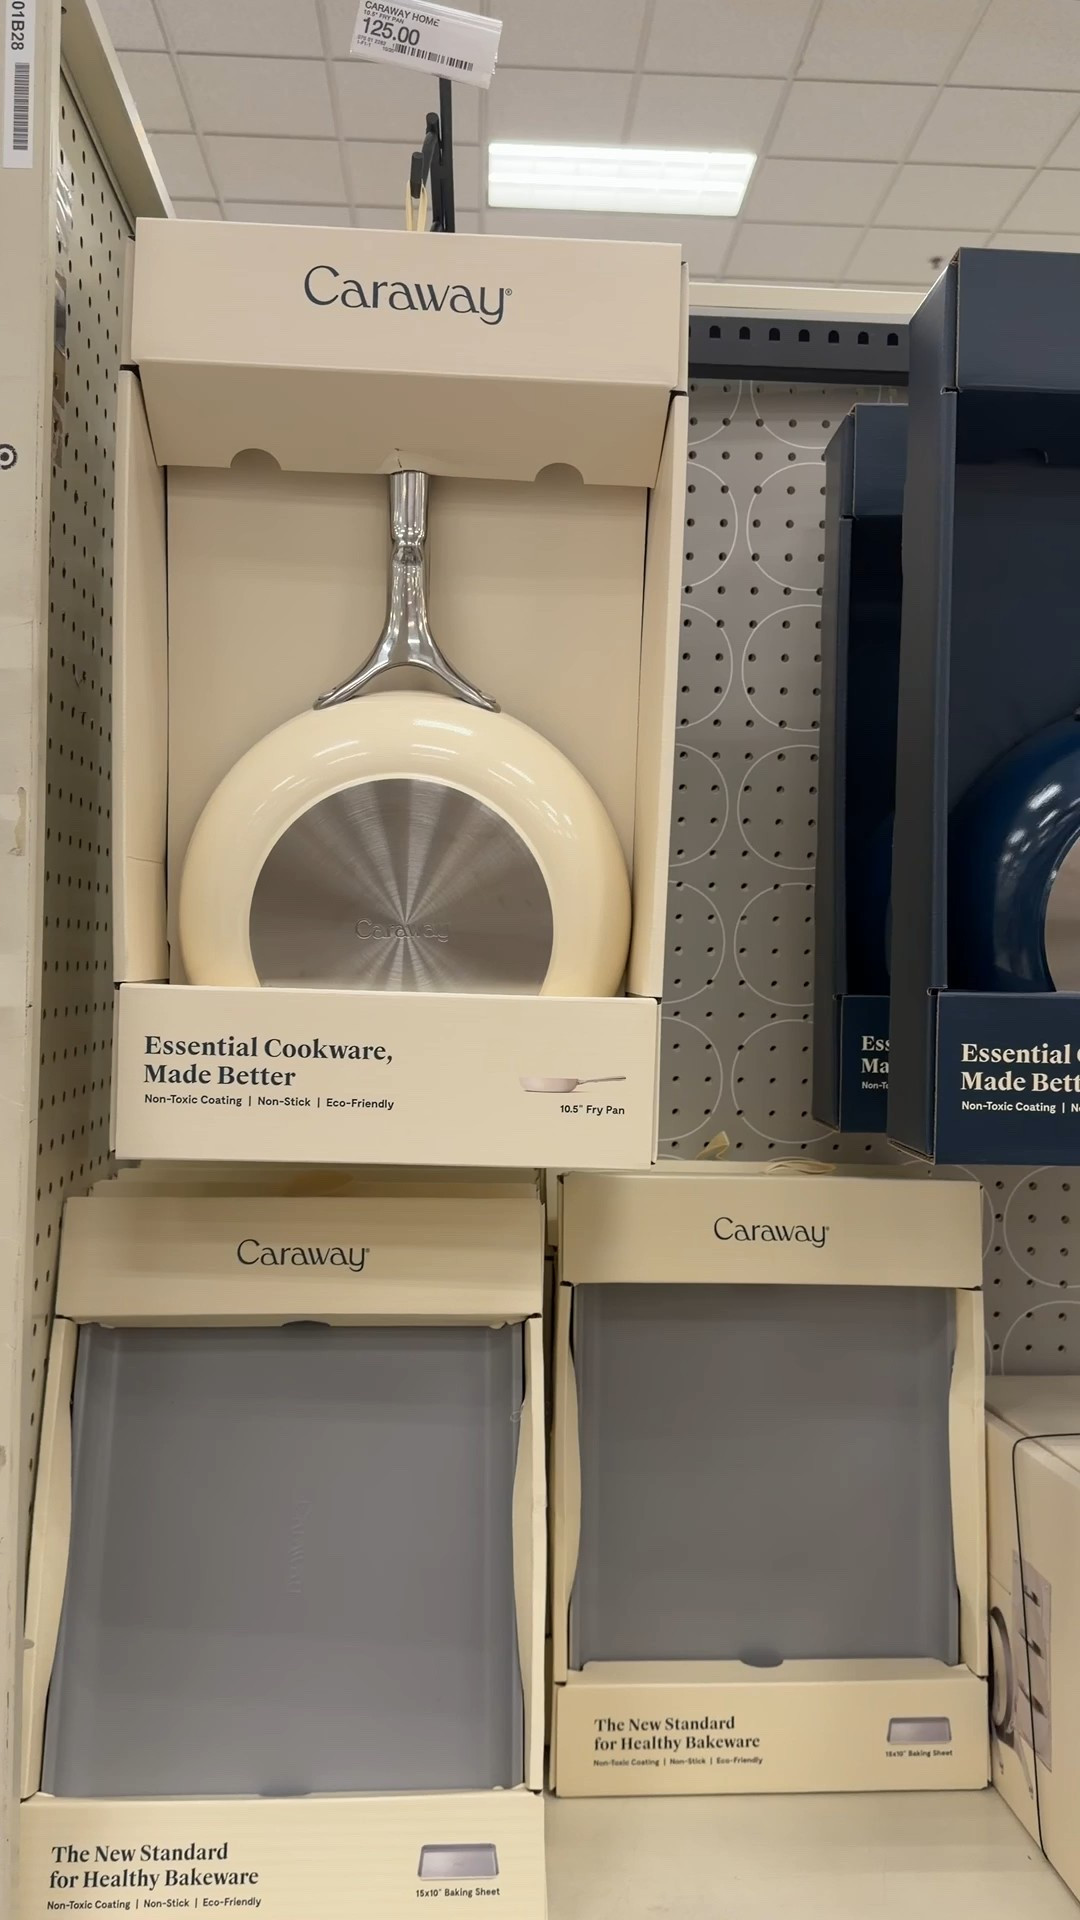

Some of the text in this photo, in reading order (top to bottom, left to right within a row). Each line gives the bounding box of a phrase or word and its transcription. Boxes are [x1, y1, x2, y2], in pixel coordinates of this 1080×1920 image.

[365, 1, 440, 27] CARAWAY HOME
[11, 1, 25, 50] 01B28
[363, 17, 420, 46] 125.00
[144, 1035, 393, 1064] Essential Cookware,
[961, 1043, 1071, 1064] Essential
[144, 1064, 296, 1086] Made Better
[960, 1071, 1026, 1091] Made
[144, 1094, 394, 1110] Non-Toxic Coating Non-Stick Eco-Friendly
[560, 1105, 625, 1116] 10.5" Fry Pan
[961, 1100, 1013, 1111] Non-Toxic
[1015, 1102, 1056, 1114] Coating
[594, 1716, 735, 1732] The New Standard
[594, 1735, 760, 1752] for Healthy Bakeware
[52, 1842, 228, 1863] The New Standard
[49, 1868, 259, 1891] for Healthy Bakeware
[444, 1888, 473, 1898] Baking
[475, 1888, 500, 1896] Sheet
[47, 1897, 262, 1910] Non-Toxic Coating Non-Stick Eco-Friendly
